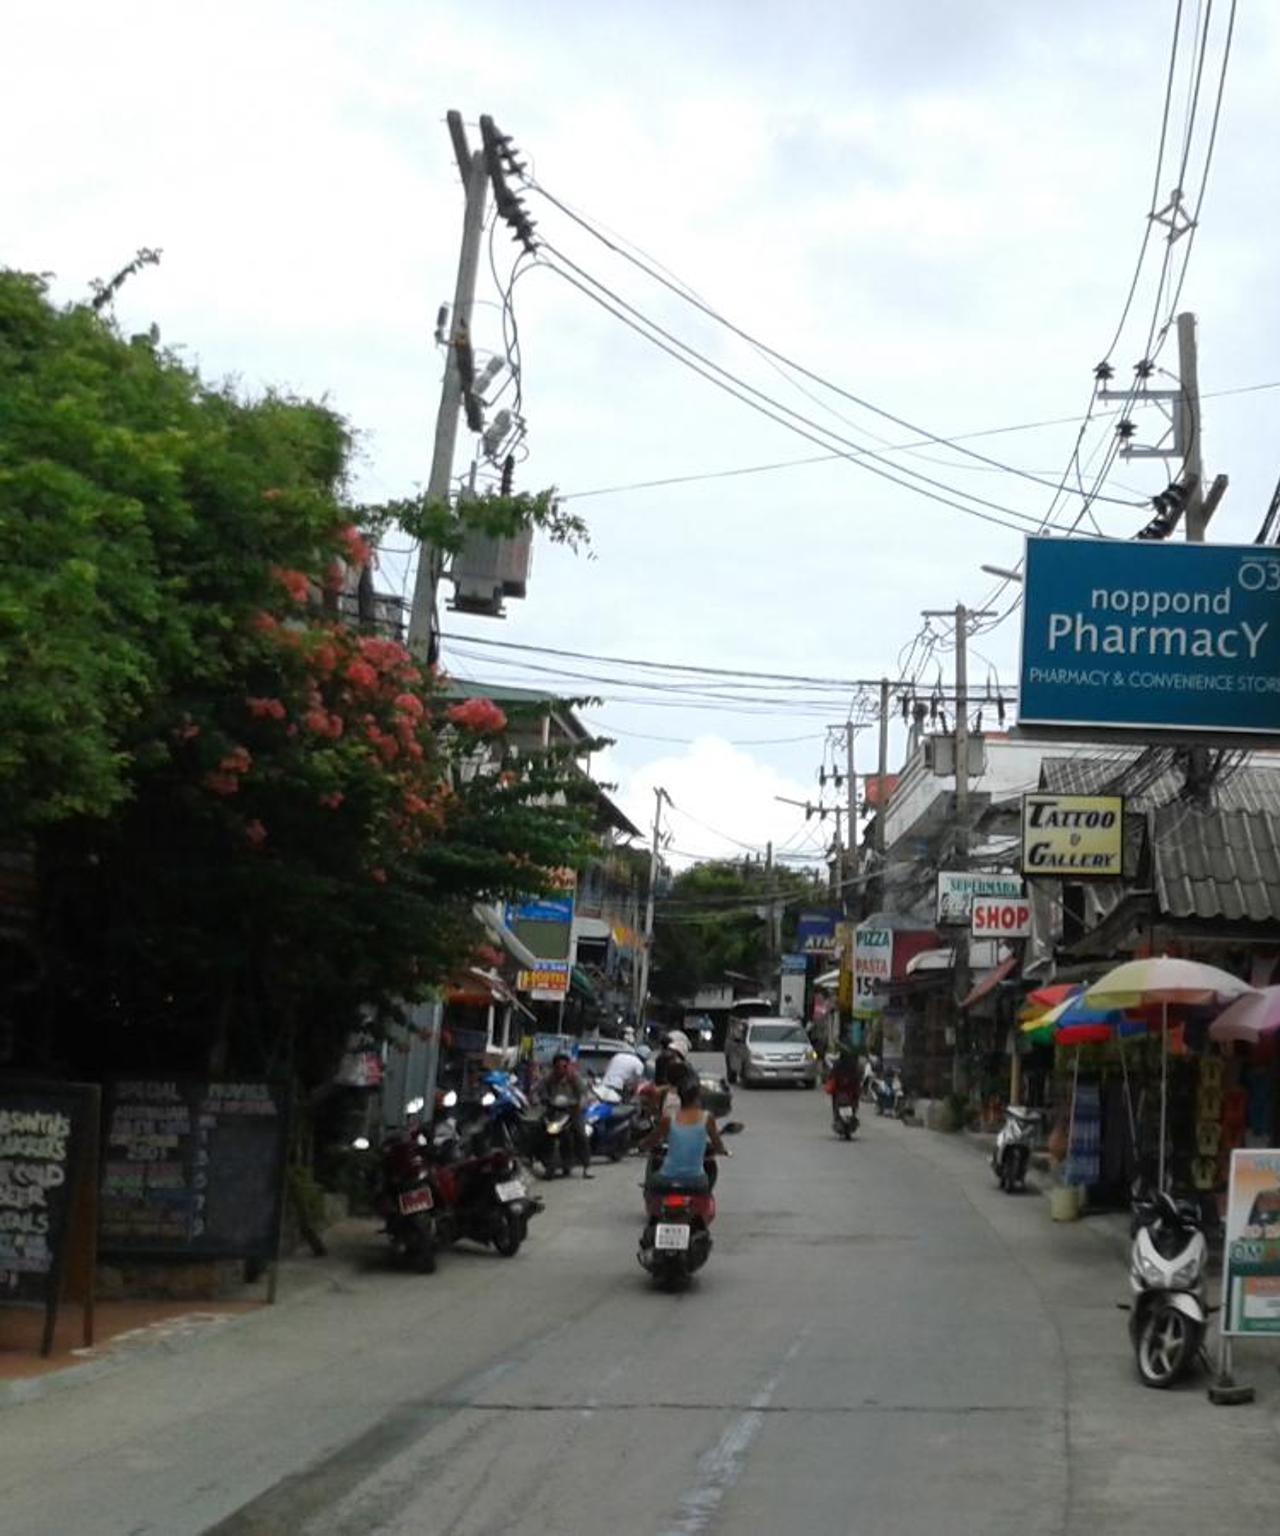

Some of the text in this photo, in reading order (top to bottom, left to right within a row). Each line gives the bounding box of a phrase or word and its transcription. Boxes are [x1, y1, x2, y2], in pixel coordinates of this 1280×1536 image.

[1091, 587, 1231, 618] noppond
[1048, 612, 1269, 659] PharmacY
[1029, 667, 1110, 685] PHARMACY
[1113, 672, 1127, 687] &
[1128, 672, 1234, 691] CONVENIENCE
[974, 905, 1030, 930] SHOP
[856, 930, 890, 947] PIZZA
[856, 958, 888, 976] PASTA
